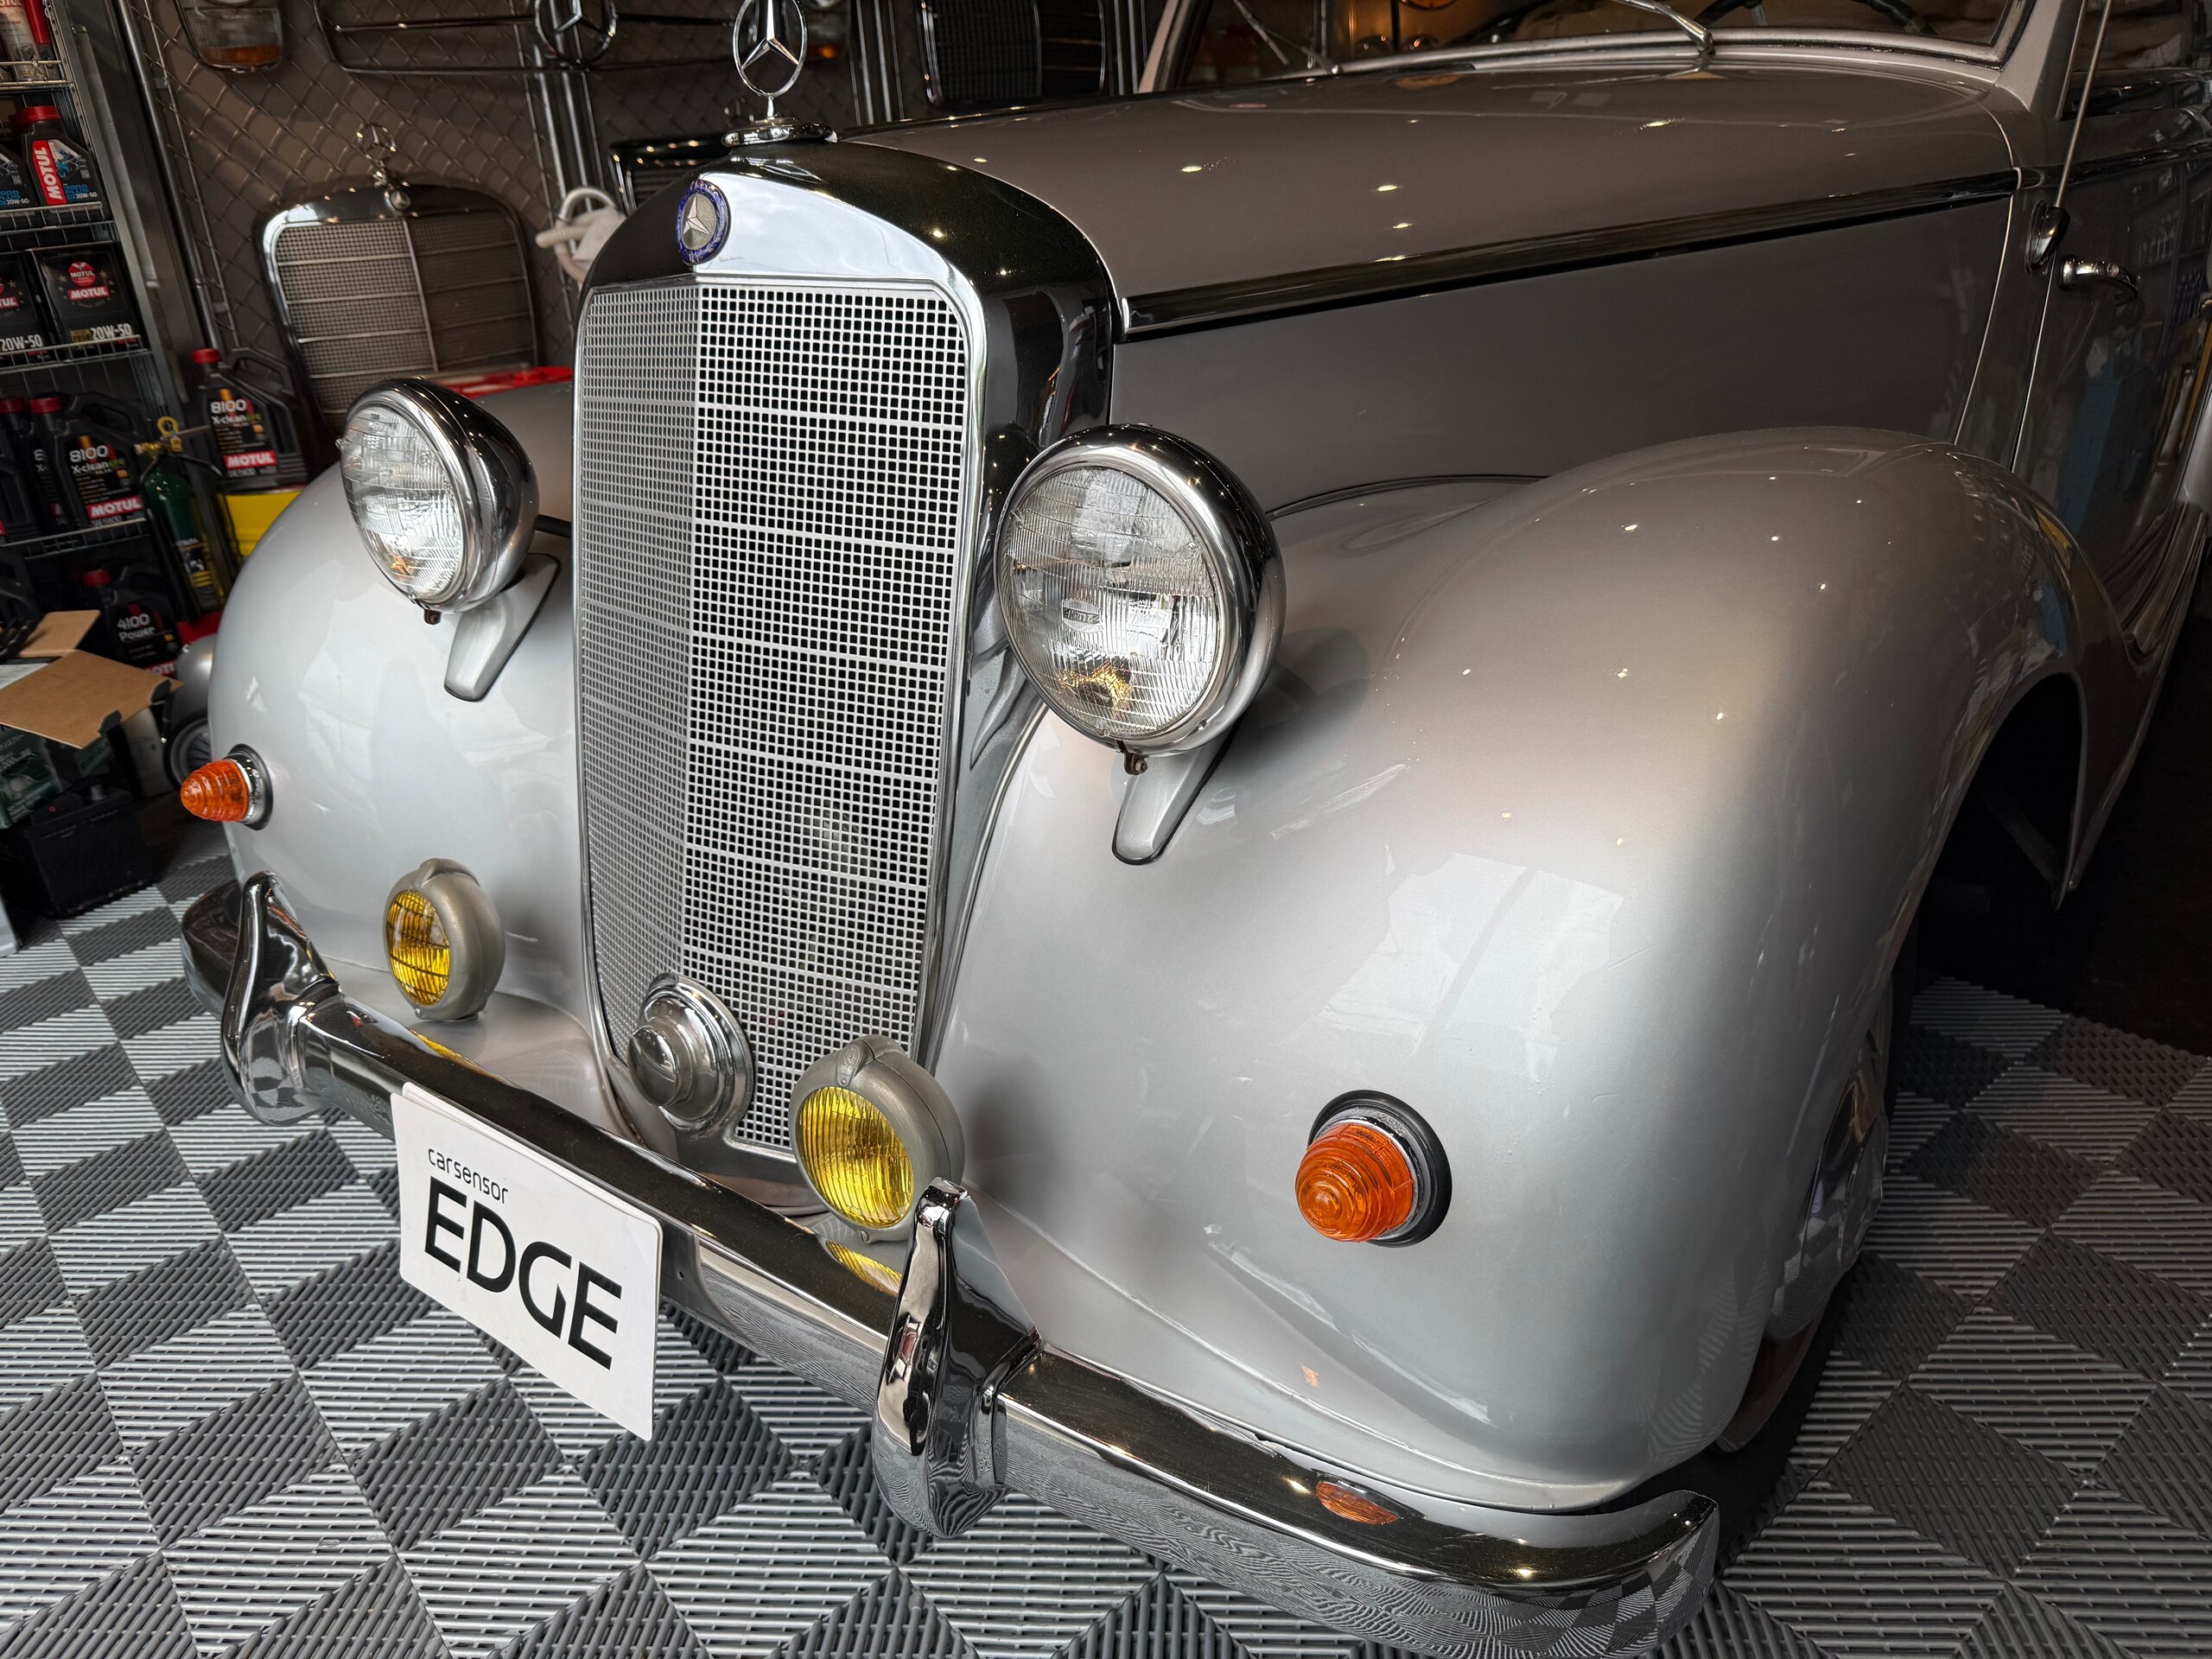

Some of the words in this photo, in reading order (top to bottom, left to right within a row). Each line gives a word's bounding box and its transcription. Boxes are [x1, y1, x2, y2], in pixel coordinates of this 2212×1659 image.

[33, 146, 63, 200] MOTUL
[6, 197, 29, 206] 20W-50
[74, 191, 98, 200] 20W-50
[69, 270, 95, 279] MOTUL
[71, 286, 109, 300] MOTUL
[90, 322, 133, 341] 20W-50
[0, 334, 43, 353] 20W-50
[210, 398, 248, 415] 8100
[69, 444, 110, 463] 8100
[226, 452, 275, 469] MOTUL
[71, 461, 109, 474] X-clean
[90, 499, 141, 519] MOTUL
[117, 613, 152, 631] 4100
[118, 626, 157, 643] Power
[428, 1147, 509, 1205] carsensor
[424, 1174, 622, 1370] EDGE
